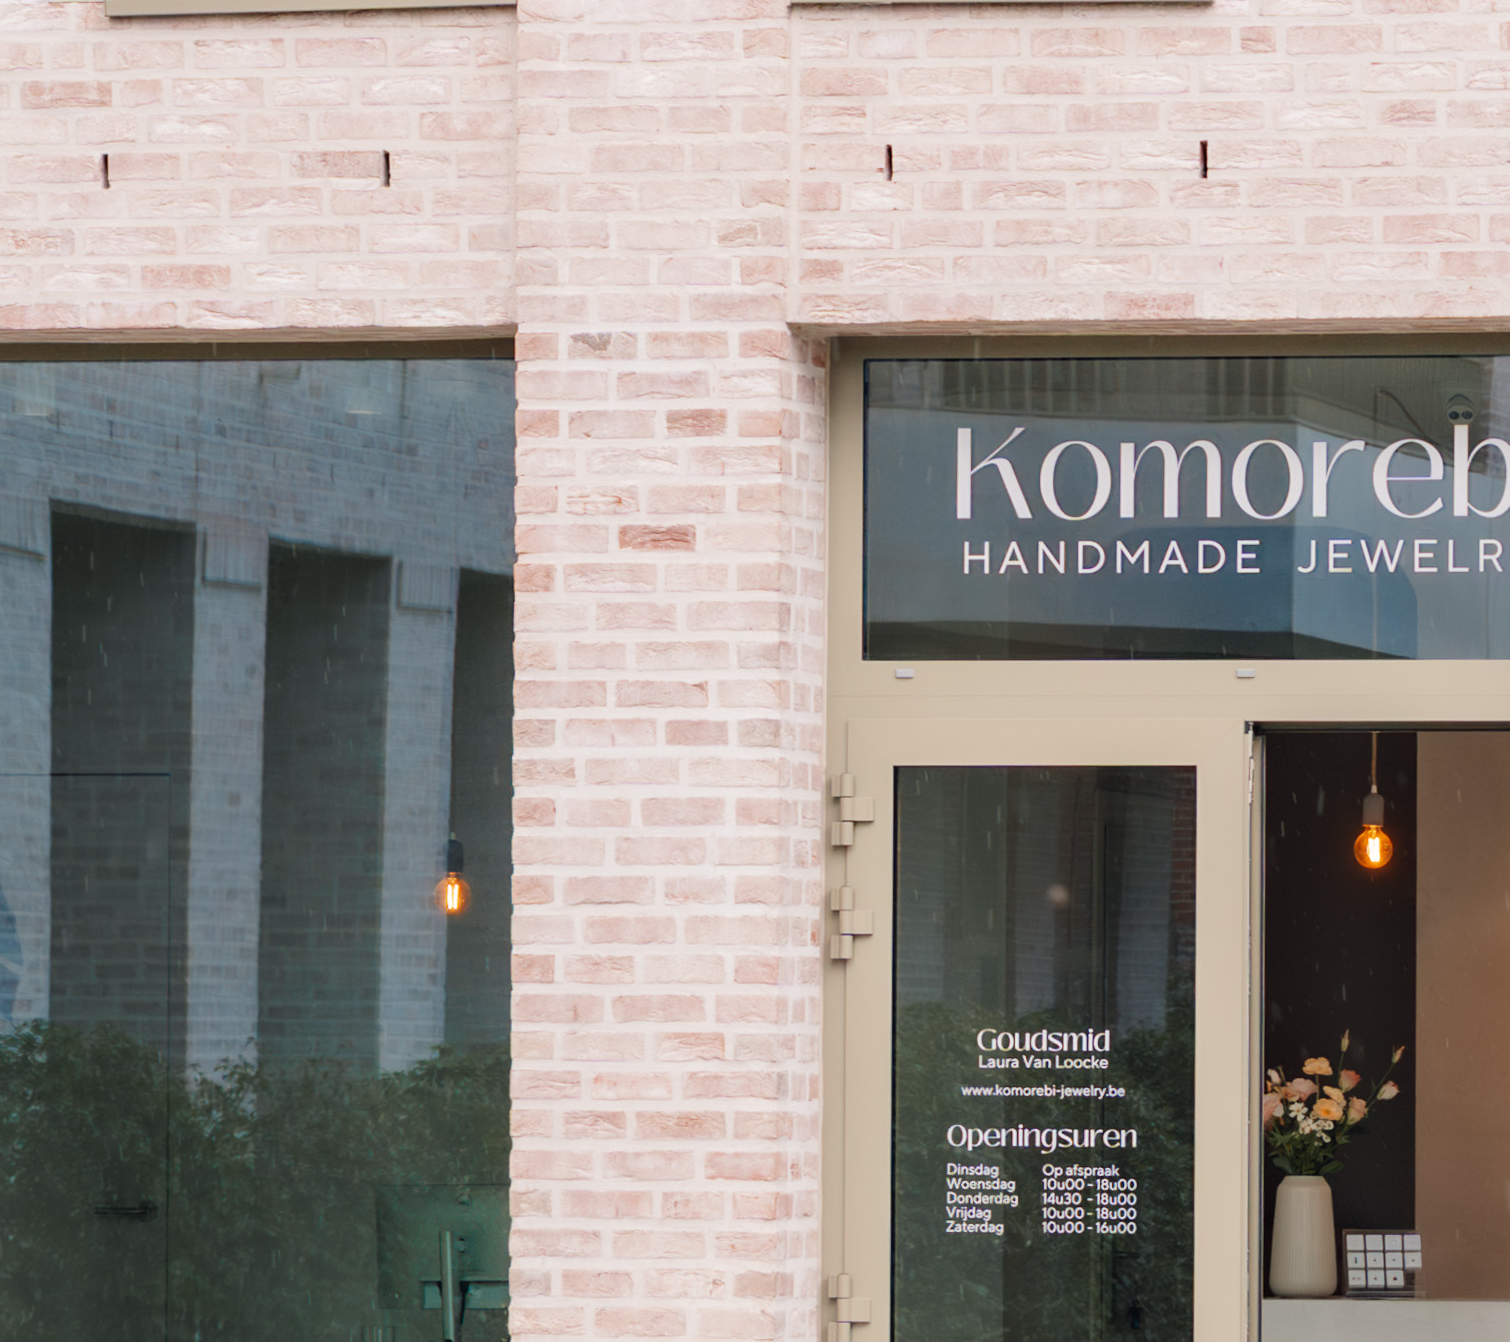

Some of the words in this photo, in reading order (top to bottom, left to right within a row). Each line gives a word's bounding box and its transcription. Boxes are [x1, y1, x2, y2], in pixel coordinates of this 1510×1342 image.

[963, 539, 1261, 575] HANDMADE
[976, 1028, 1110, 1053] Goudsmid
[978, 1055, 1020, 1069] Laura
[1022, 1055, 1052, 1069] Van
[1055, 1055, 1109, 1069] Loocke
[961, 1083, 1126, 1100] www.komorebi-jewelry.be
[947, 1124, 1137, 1154] Openingsuren
[946, 1162, 1000, 1178] Dinsdag
[1042, 1163, 1064, 1179] Op
[1065, 1163, 1120, 1179] afspraak
[946, 1177, 1016, 1193] Woensdag
[1042, 1178, 1085, 1191] 10u00
[1095, 1178, 1137, 1191] 18u00
[946, 1191, 1019, 1207] Donderdag
[1042, 1192, 1082, 1205] 14u30
[1095, 1192, 1137, 1205] 18u00
[946, 1206, 992, 1222] Vrijdag
[1042, 1207, 1085, 1220] 10u00
[1095, 1207, 1137, 1220] 18u00
[946, 1220, 1004, 1234] Zaterdag
[1042, 1221, 1085, 1234] 10u00
[1095, 1221, 1137, 1234] 16u00
